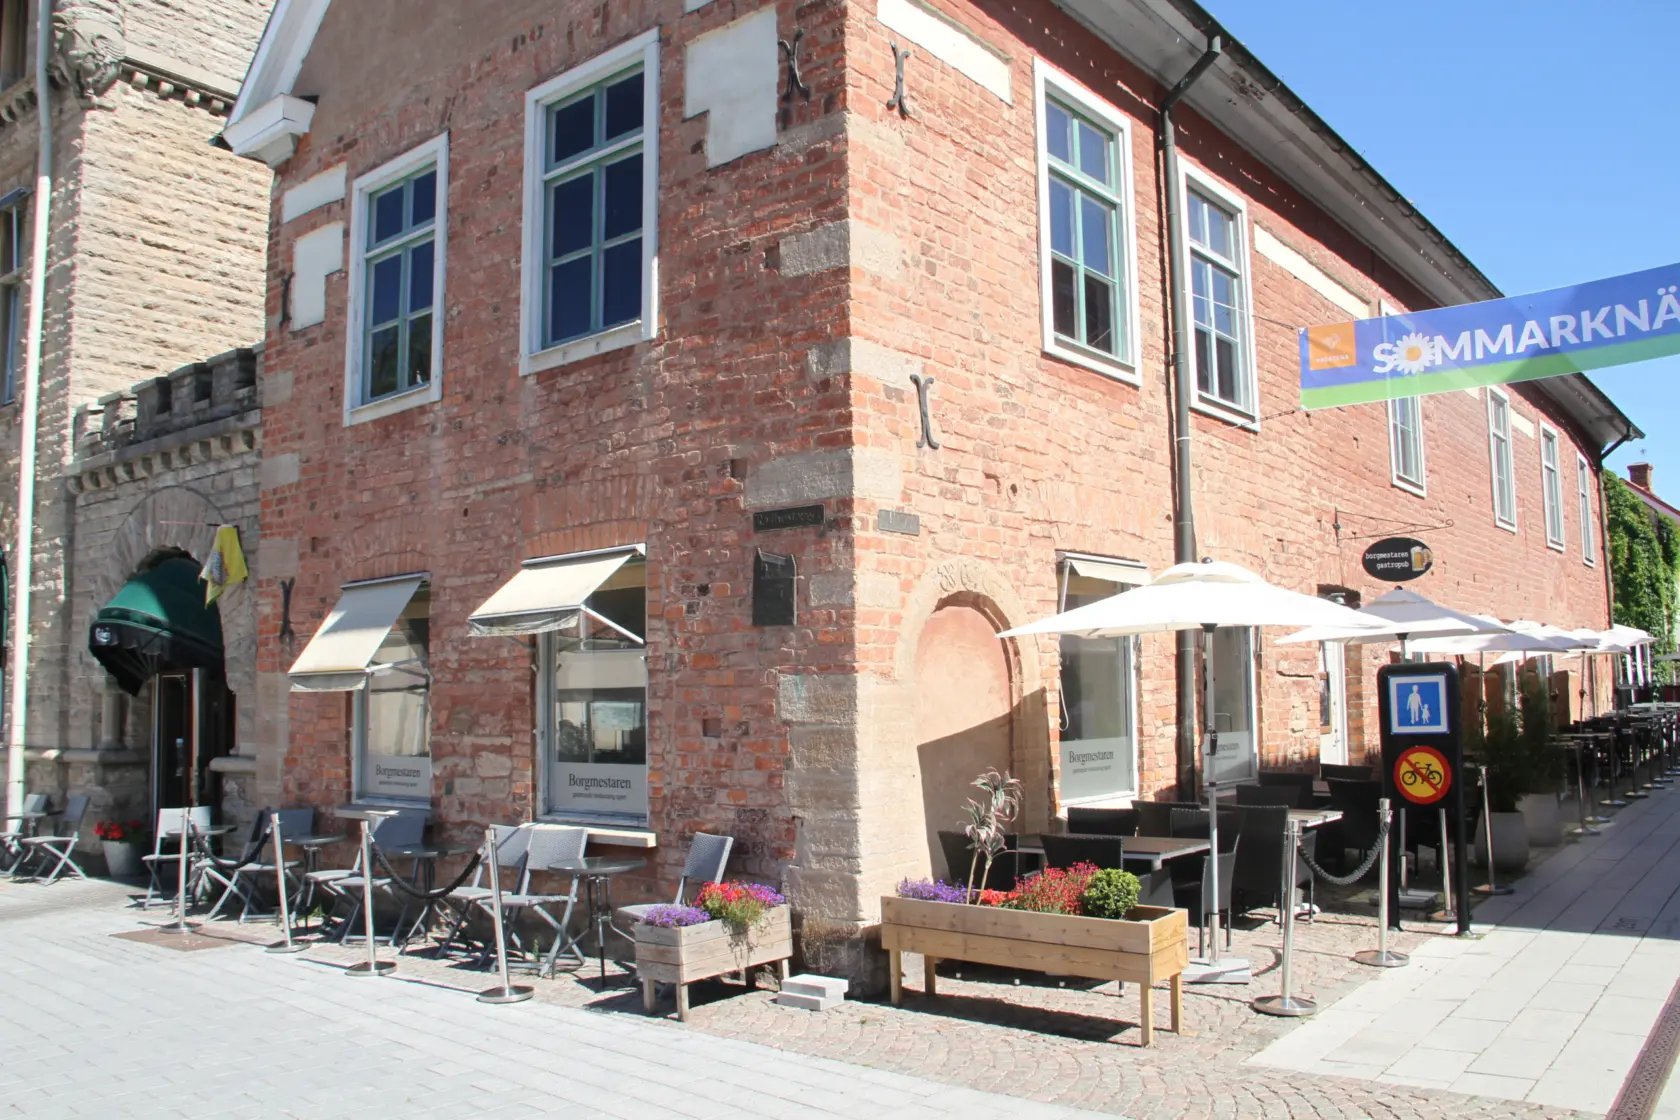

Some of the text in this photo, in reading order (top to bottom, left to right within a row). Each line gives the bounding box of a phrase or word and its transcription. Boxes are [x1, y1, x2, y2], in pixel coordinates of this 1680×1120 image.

[1365, 552, 1409, 560] borgmestaren
[1376, 561, 1410, 570] gastropub
[1069, 750, 1114, 765] Borgmestaren
[375, 763, 420, 779] Borgmestaren
[568, 773, 631, 790] Borgmestaren
